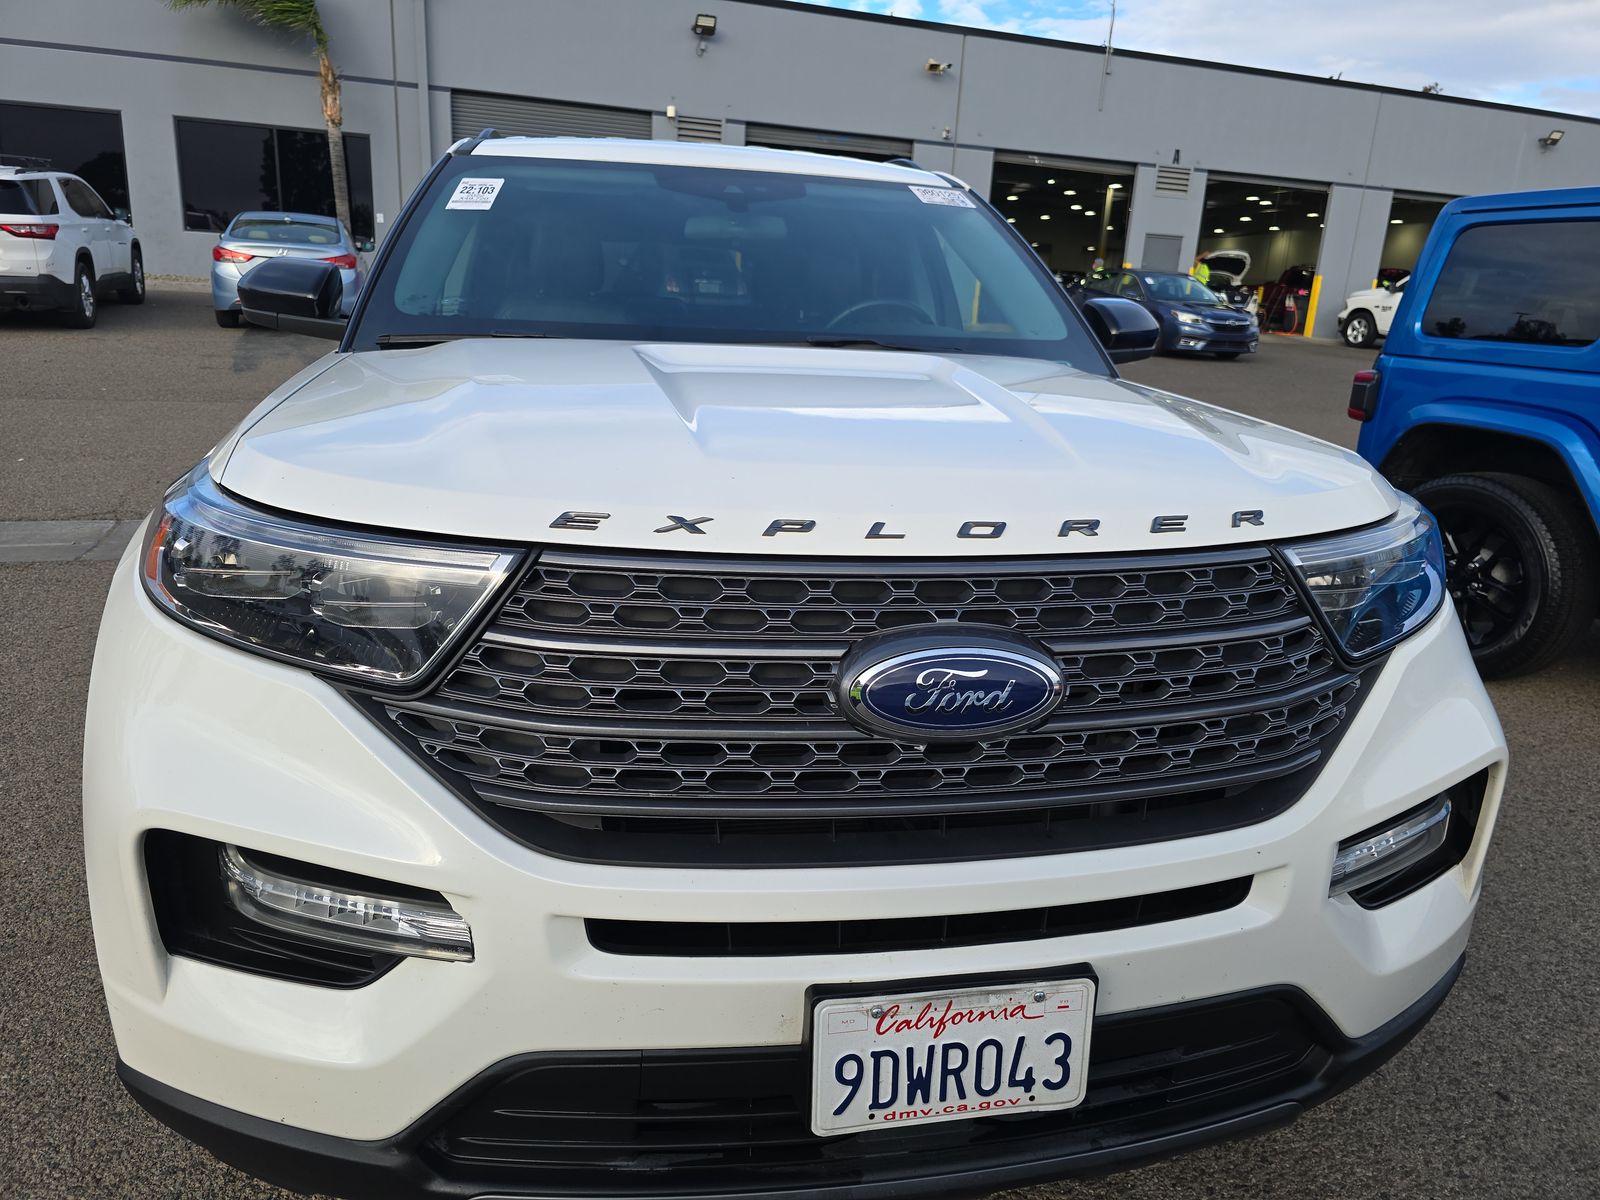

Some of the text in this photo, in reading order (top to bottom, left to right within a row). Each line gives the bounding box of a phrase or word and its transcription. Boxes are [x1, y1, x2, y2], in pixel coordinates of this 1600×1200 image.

[460, 186, 496, 195] 22:103
[549, 509, 1265, 539] EXPLORER
[904, 667, 1016, 714] Ford
[875, 997, 1044, 1039] California
[832, 1032, 1072, 1116] 9DWR043
[883, 1097, 1021, 1121] dmv.ca.gov
